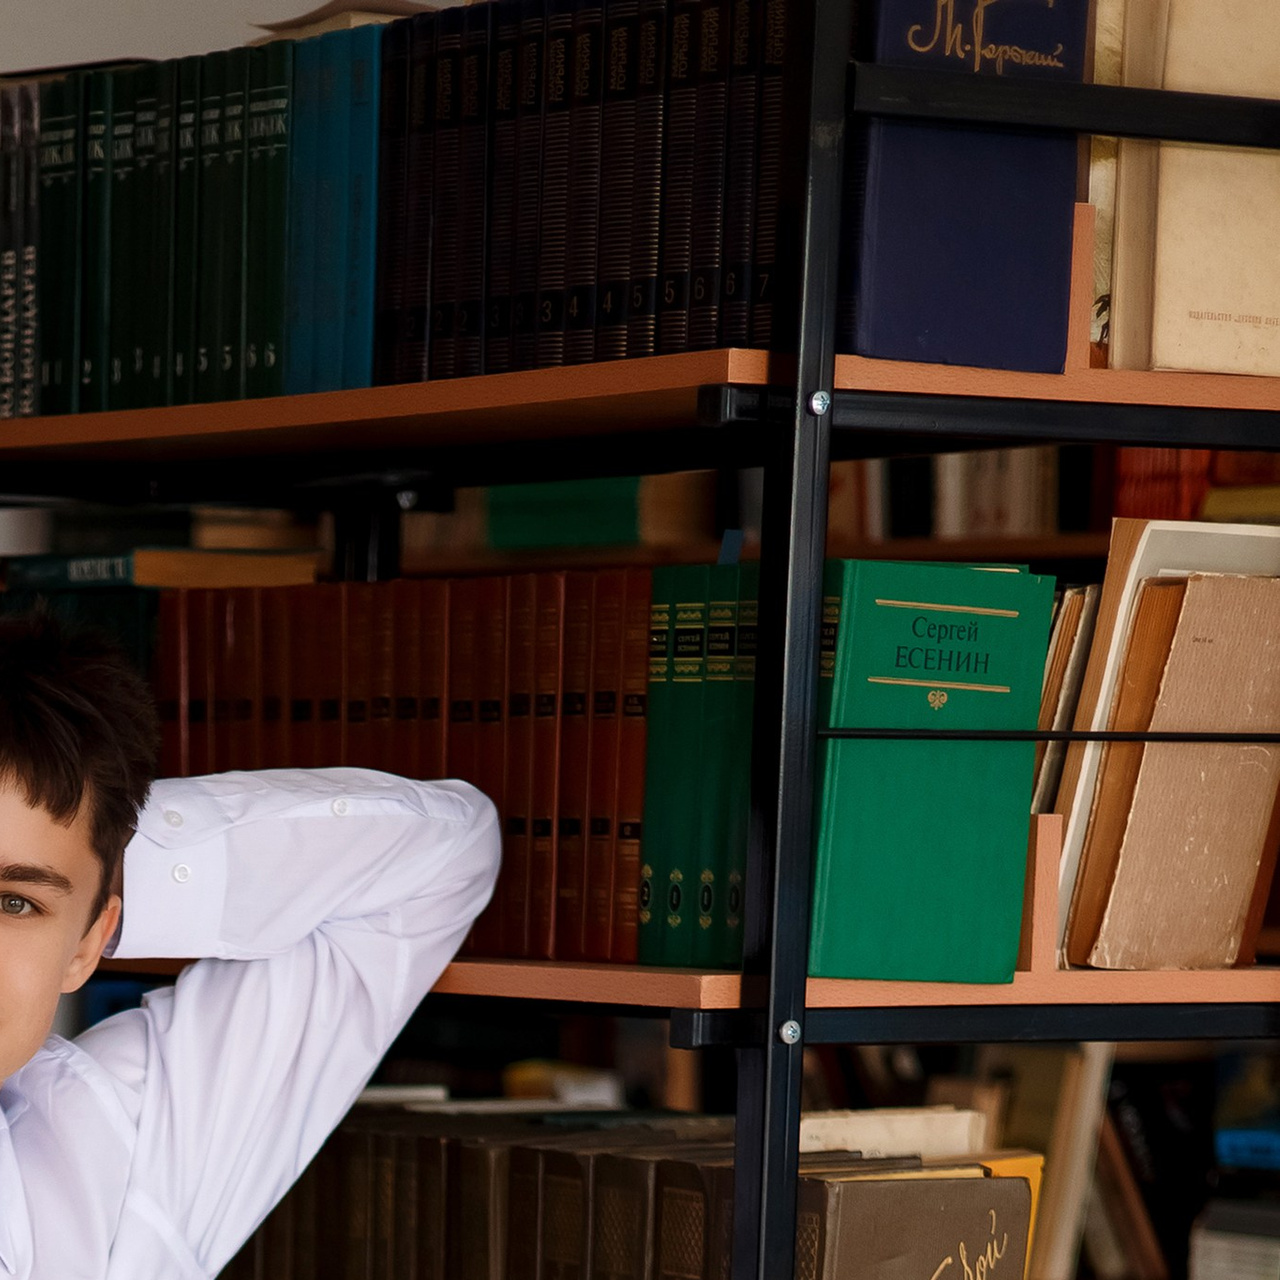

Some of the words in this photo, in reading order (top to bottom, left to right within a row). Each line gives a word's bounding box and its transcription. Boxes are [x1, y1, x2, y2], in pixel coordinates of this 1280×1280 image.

[555, 37, 566, 102] ГОРЬКИЙ
[617, 26, 628, 91] ГОРЬКИЙ
[679, 13, 690, 79] ГОРЬКИЙ
[707, 6, 720, 72] ГОРЬКИЙ
[894, 645, 990, 674] ЕСЕНИН
[911, 615, 979, 644] Сергей
